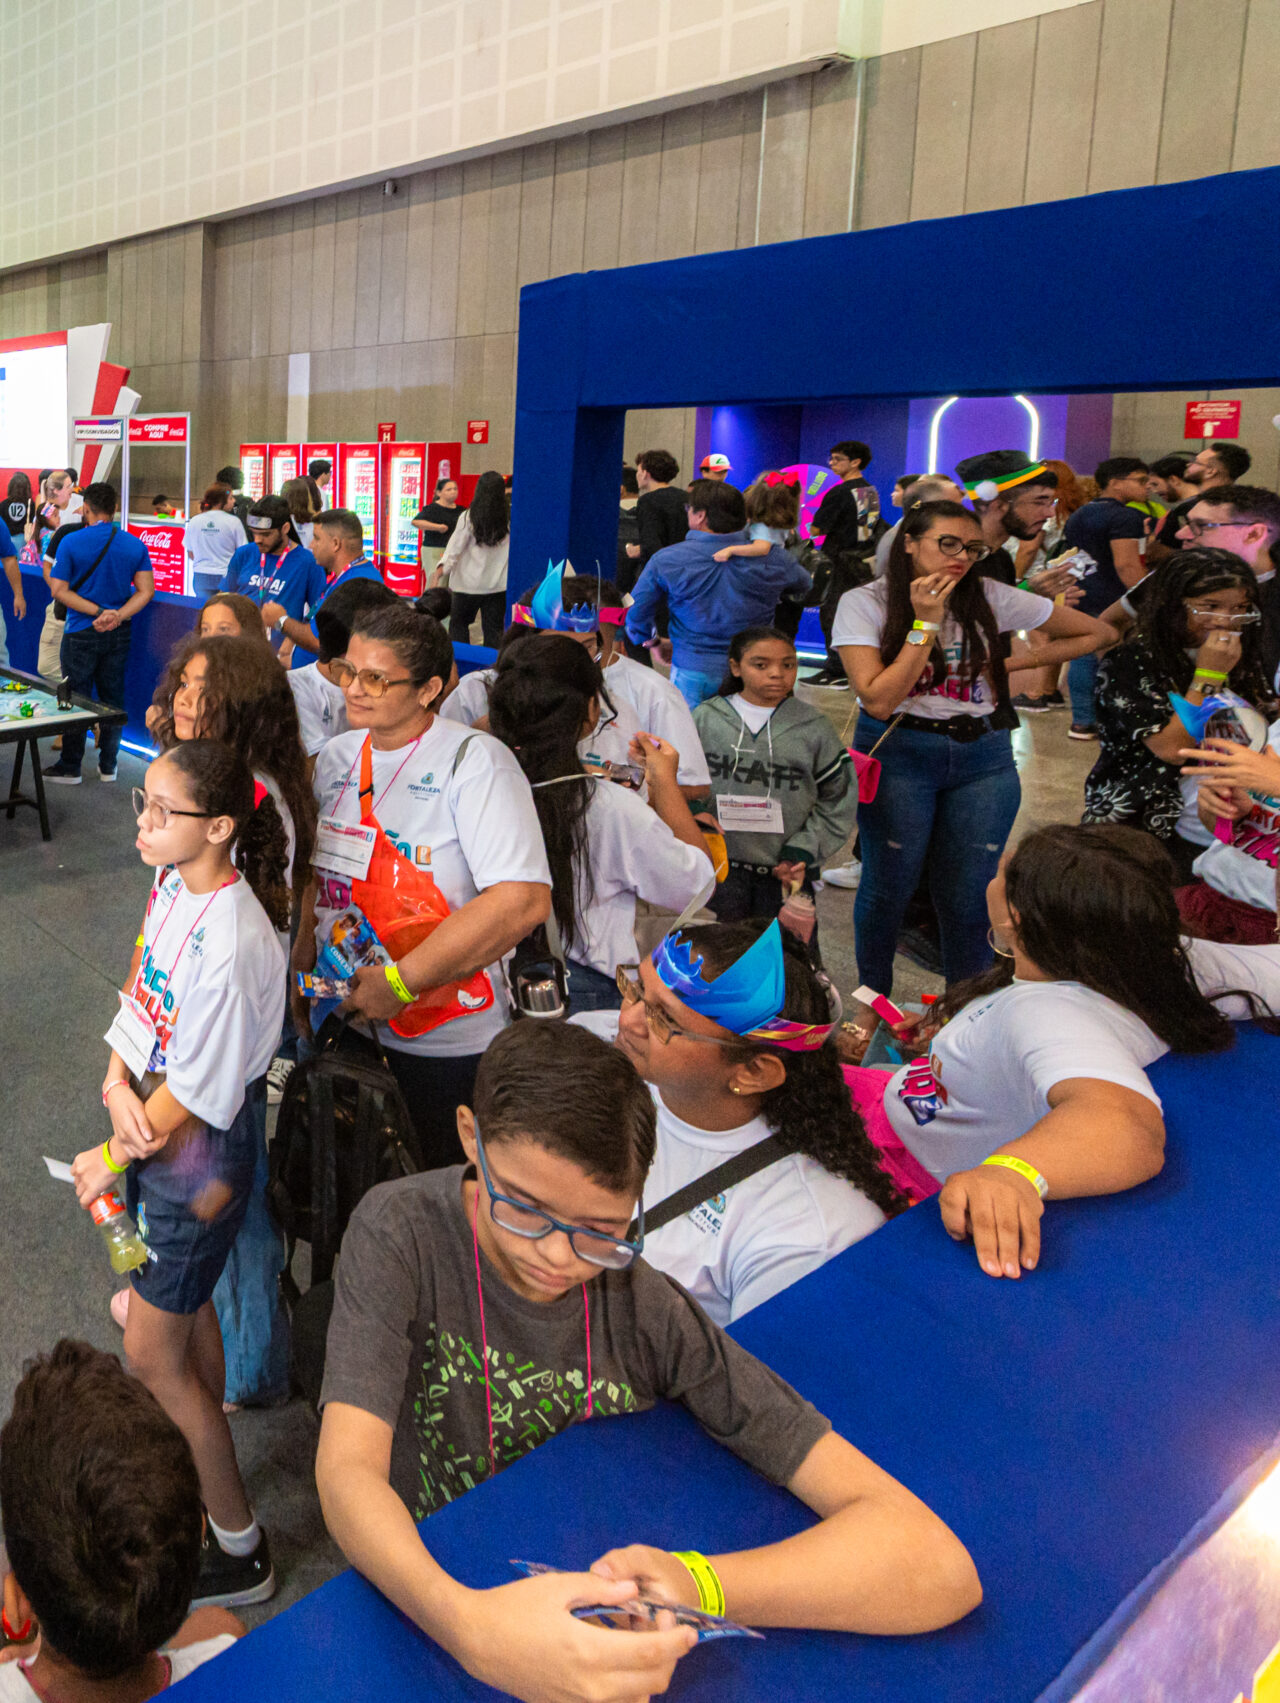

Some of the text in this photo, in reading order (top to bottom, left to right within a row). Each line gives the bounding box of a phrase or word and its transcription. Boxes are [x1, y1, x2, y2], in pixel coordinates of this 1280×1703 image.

[144, 424, 169, 432] COMPRE
[148, 431, 164, 439] AQUI
[704, 751, 808, 792] SKATE
[407, 784, 441, 794] FORTALEZA
